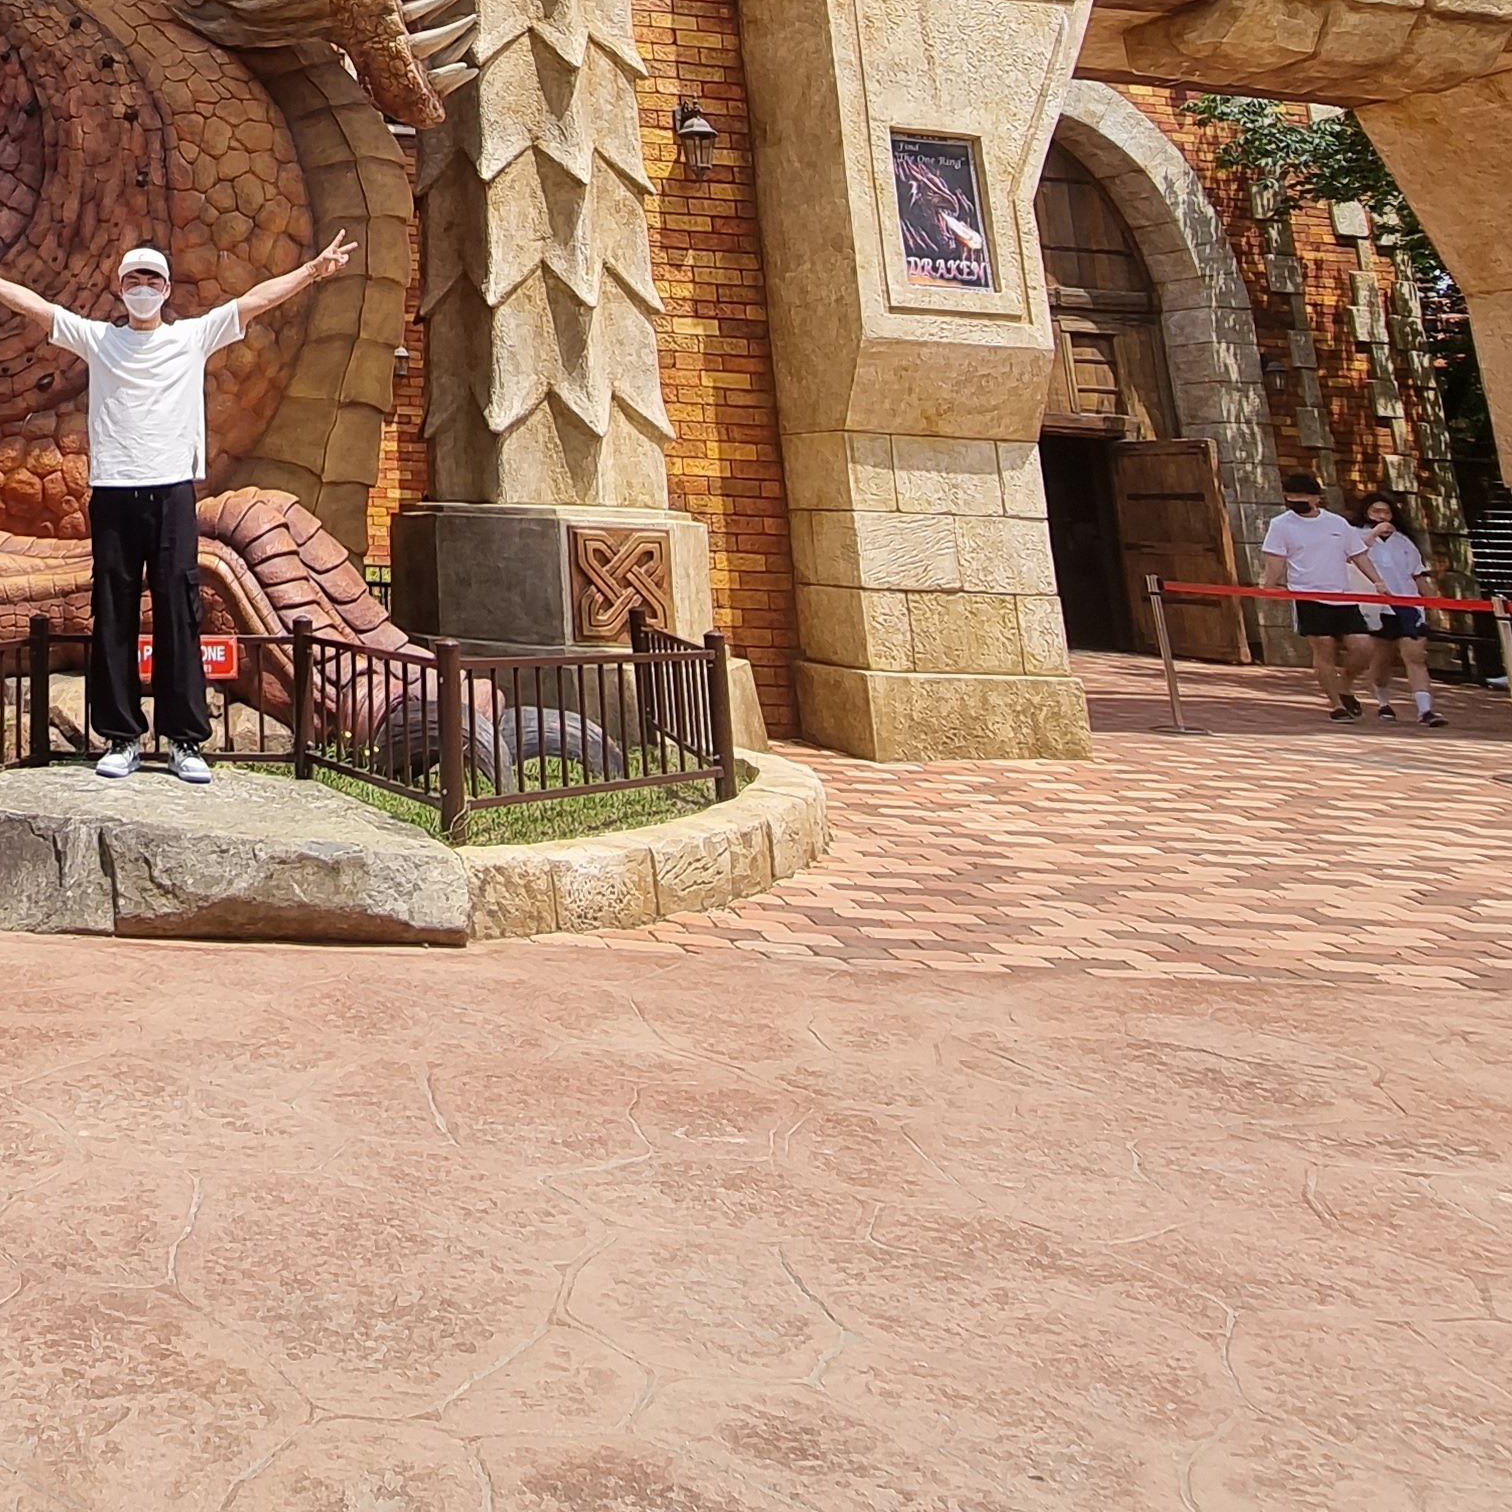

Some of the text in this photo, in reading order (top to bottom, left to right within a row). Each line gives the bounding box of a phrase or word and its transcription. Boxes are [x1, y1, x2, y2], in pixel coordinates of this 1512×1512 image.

[898, 142, 920, 152] Find
[917, 154, 936, 164] One
[906, 256, 986, 285] DRAKEN
[200, 645, 225, 662] ONE
